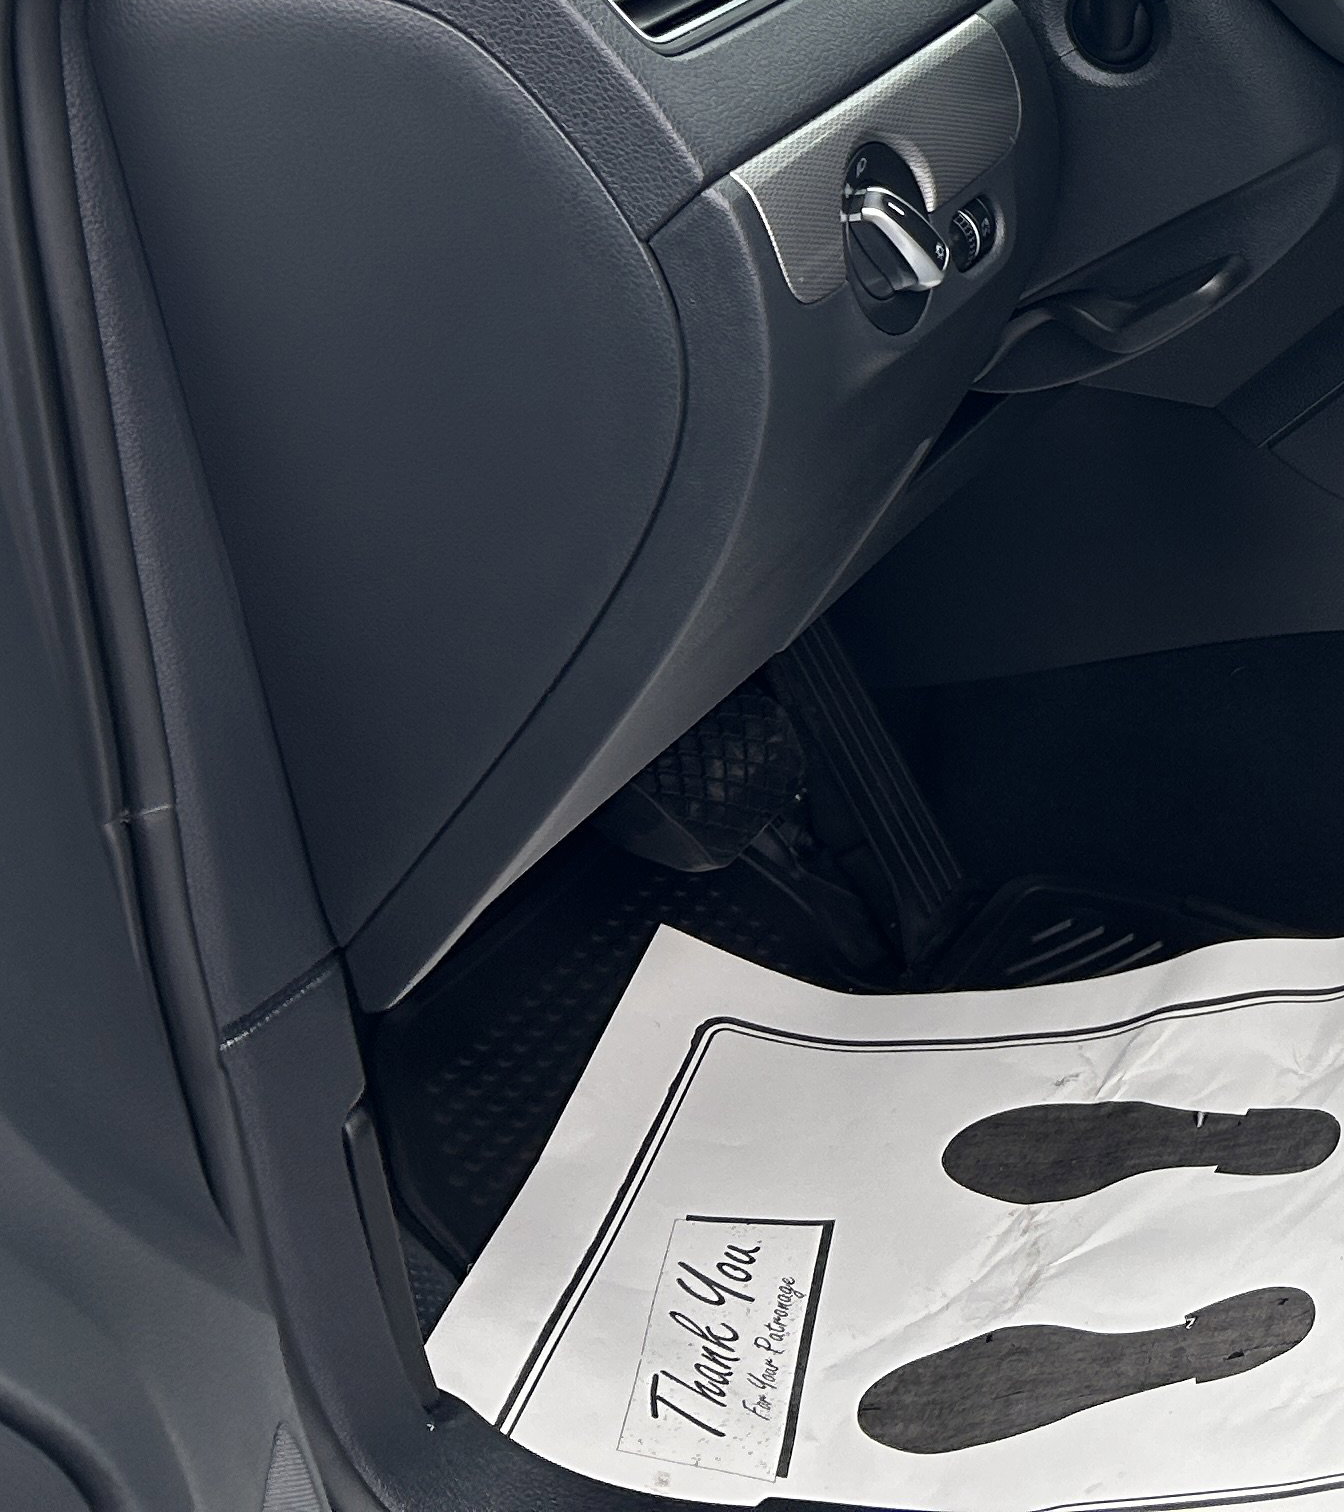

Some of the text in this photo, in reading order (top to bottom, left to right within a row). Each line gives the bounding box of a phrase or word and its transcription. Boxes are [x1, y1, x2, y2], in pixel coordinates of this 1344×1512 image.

[649, 1243, 761, 1438] Thank You
[742, 1275, 807, 1422] For Your Patronage
